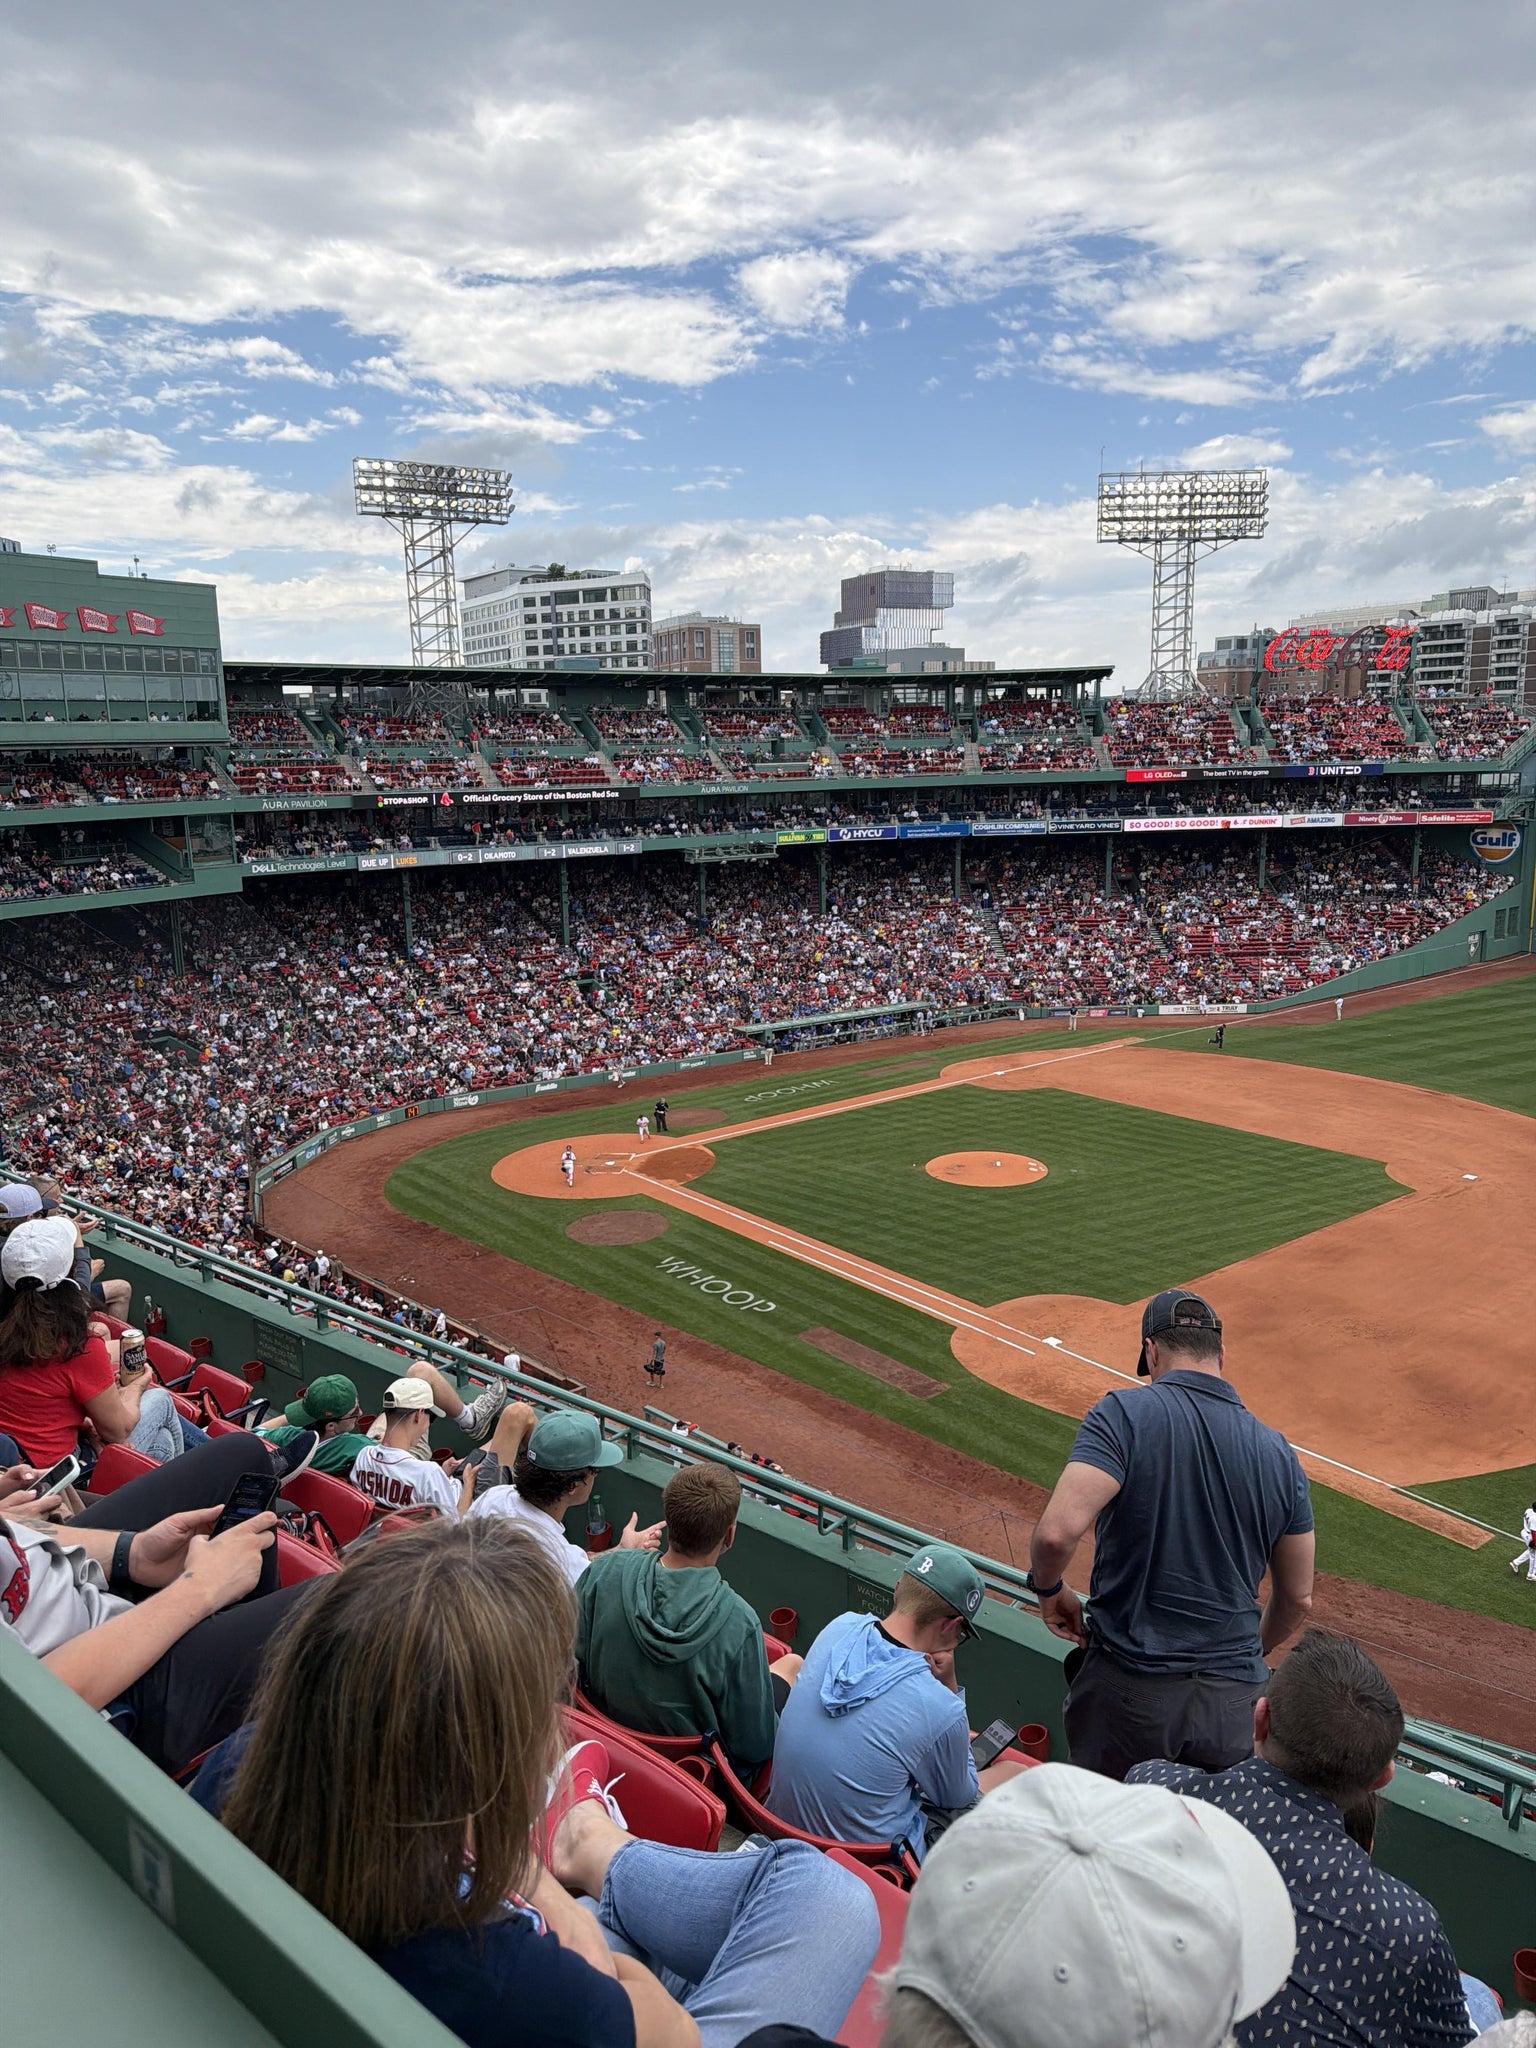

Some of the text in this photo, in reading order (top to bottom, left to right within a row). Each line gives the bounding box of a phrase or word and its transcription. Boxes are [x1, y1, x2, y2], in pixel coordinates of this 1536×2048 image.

[1252, 769, 1270, 777] game
[1320, 765, 1362, 776] UNITED
[721, 784, 749, 793] PAVILION
[383, 796, 429, 806] STOP&SHOP
[462, 790, 620, 803] Official Grocery Store of the Boston Red Sox
[291, 799, 328, 808] PAVILION
[1306, 816, 1336, 824] AMAZING
[1358, 815, 1378, 823] Ninety
[1421, 814, 1456, 822] Safelite
[1004, 822, 1046, 830] COMPANIES
[1057, 823, 1096, 831] VINEYARD
[1129, 821, 1142, 829] SO
[1143, 820, 1173, 829] GOOD!
[1174, 820, 1187, 828] SO
[1189, 819, 1219, 827] GOOD!
[1248, 818, 1278, 826] DUNKIN'
[853, 829, 884, 838] HYCU
[1471, 831, 1518, 848] Gulf
[361, 844, 635, 868] DUE UP LUKES 0-2 OKAMOTO 1-2 VALENZUELA 1-2
[251, 857, 346, 874] DELL Technologies Level
[655, 1255, 777, 1313] WHOOP
[356, 1470, 415, 1506] YOSHIDA
[857, 1584, 890, 1605] WATCH
[861, 1599, 887, 1617] FOUL
